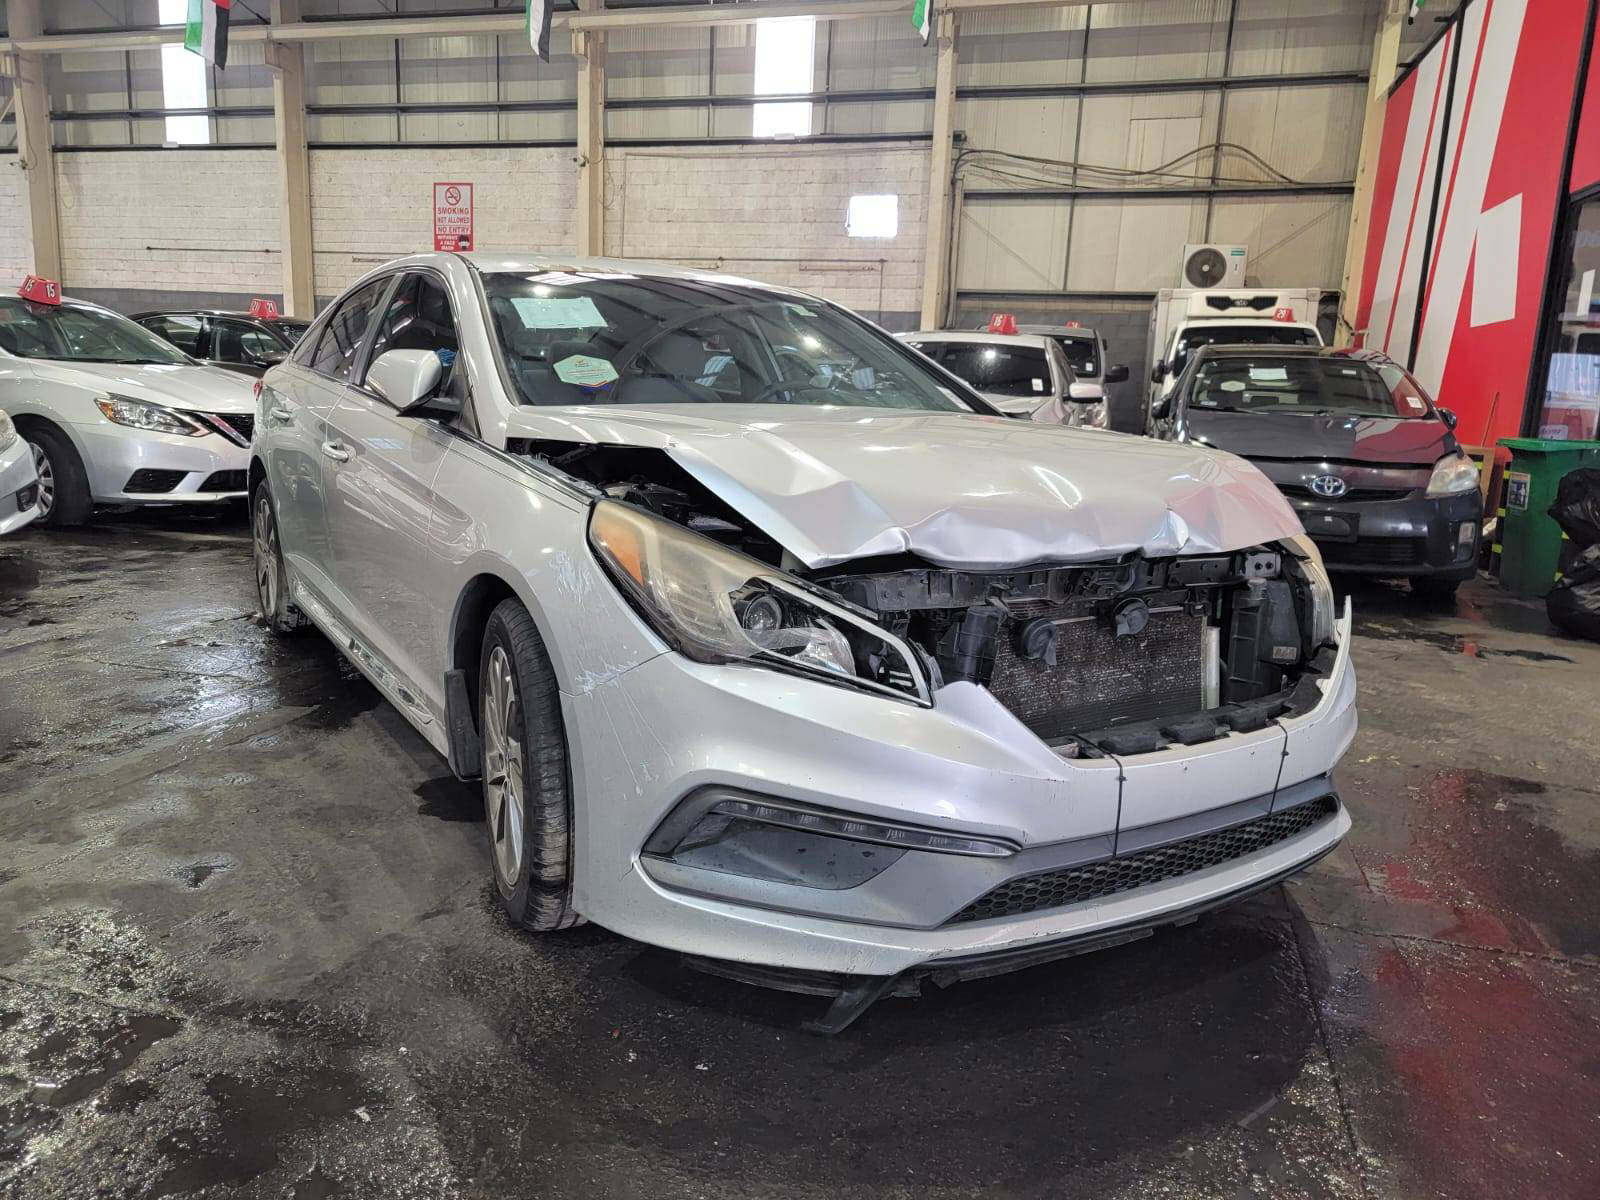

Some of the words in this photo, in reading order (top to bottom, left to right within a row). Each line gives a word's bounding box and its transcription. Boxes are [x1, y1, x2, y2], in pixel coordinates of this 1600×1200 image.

[437, 207, 469, 215] SMOKING
[438, 216, 447, 224] NOT
[448, 216, 469, 224] ALLOWED
[438, 226, 447, 234] NO
[449, 226, 469, 234] ENTRY
[46, 282, 56, 298] 15
[266, 301, 275, 313] 21
